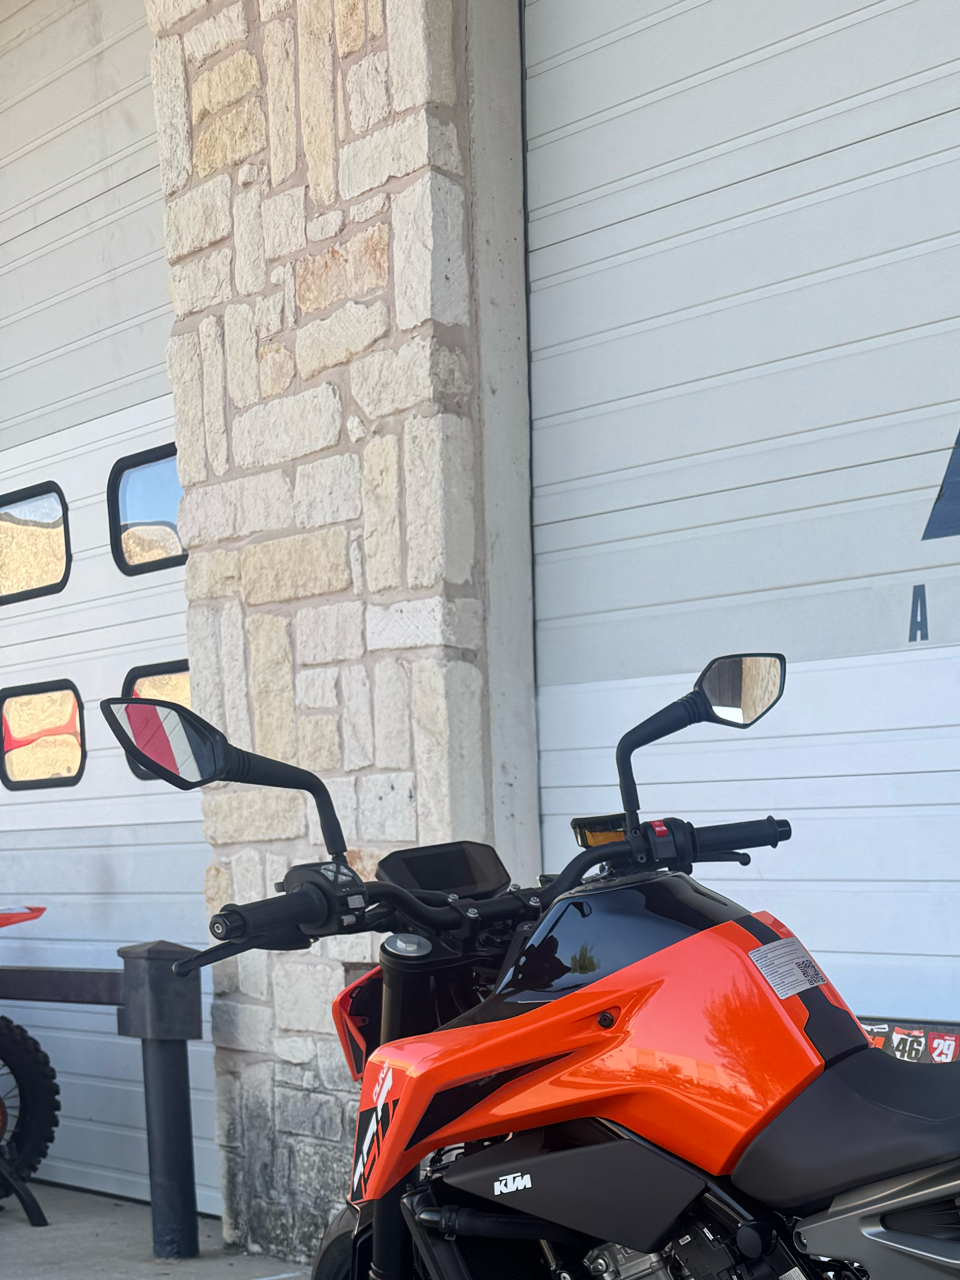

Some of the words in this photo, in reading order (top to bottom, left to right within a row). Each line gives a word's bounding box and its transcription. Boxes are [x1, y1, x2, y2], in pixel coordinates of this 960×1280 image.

[895, 1037, 922, 1060] 46
[932, 1039, 956, 1062] 29
[493, 1172, 532, 1196] KTM
